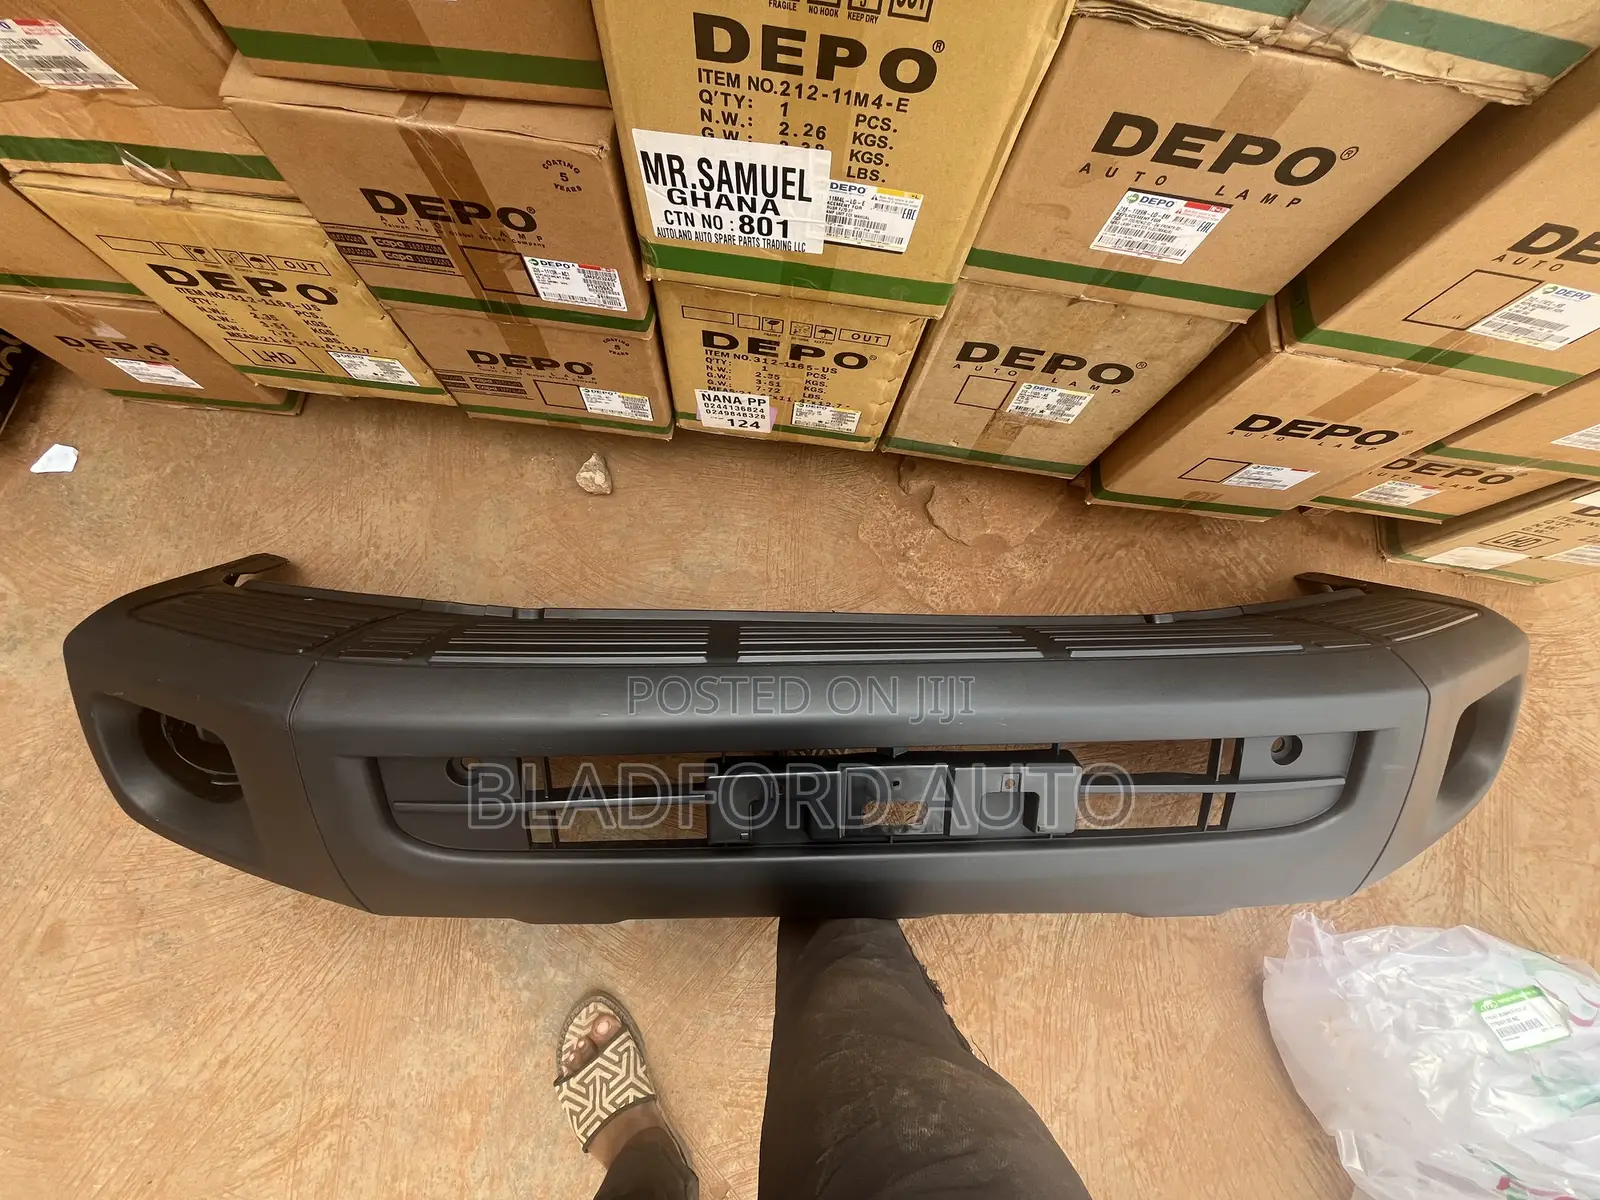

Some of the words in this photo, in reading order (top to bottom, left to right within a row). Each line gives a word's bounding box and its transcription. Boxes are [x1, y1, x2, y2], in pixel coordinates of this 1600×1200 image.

[768, 0, 797, 12] FRAGILE
[808, 5, 819, 15] NO
[820, 6, 839, 18] HOOK
[847, 11, 864, 21] KEEP
[865, 14, 879, 24] DRY
[693, 12, 937, 93] DEPO
[697, 67, 741, 89] ITEM
[780, 102, 789, 117] 1
[855, 113, 898, 133] PCS.
[779, 121, 827, 141] 2.26
[851, 131, 894, 150] KGS.
[1091, 111, 1337, 187] DEPO
[542, 159, 580, 174] COATING
[849, 149, 890, 167] KGS.
[559, 172, 569, 182] 5
[846, 166, 886, 183] LBS.
[553, 182, 582, 193] YEARS
[829, 181, 866, 194] DEPO
[1078, 162, 1168, 186] AUTO
[1215, 185, 1303, 208] LAMP
[359, 187, 538, 233] DEPO
[666, 188, 780, 216] GHANA
[1139, 195, 1175, 208] DEPO
[664, 209, 695, 227] CTN
[701, 214, 723, 230] NO
[656, 227, 692, 240] AUTOLAND
[694, 231, 713, 243] AUTO
[714, 233, 736, 245] SPARE
[738, 236, 760, 248] PARTS
[762, 238, 792, 252] TRADING
[794, 242, 806, 253] LLC
[284, 260, 318, 272] OUT
[540, 260, 571, 269] DEPO
[1491, 253, 1564, 272] AUTO
[145, 262, 339, 305] DEPO
[1555, 288, 1592, 300] DEPO
[54, 334, 170, 356] DEPO
[851, 332, 883, 344] OUT
[251, 348, 297, 365] LHD
[701, 329, 868, 370] DEPO
[704, 349, 730, 359] ITEM
[466, 349, 593, 376] DEPO
[955, 341, 1135, 385] DEPO
[804, 379, 828, 388] KGS.
[806, 372, 829, 381] PCS.
[952, 363, 1018, 377] AUTO
[1051, 377, 1121, 395] LAMP
[802, 393, 824, 401] LBS.
[803, 386, 826, 394] KGS.
[1032, 385, 1057, 393] DEPO
[701, 393, 742, 405] NANA
[747, 397, 767, 407] PP
[727, 418, 761, 430] 124
[1233, 413, 1400, 446] DEPO
[1226, 430, 1285, 442] AUTO
[1317, 441, 1378, 452] LAMP
[1381, 457, 1514, 485] DEPO
[1492, 533, 1543, 548] LHD
